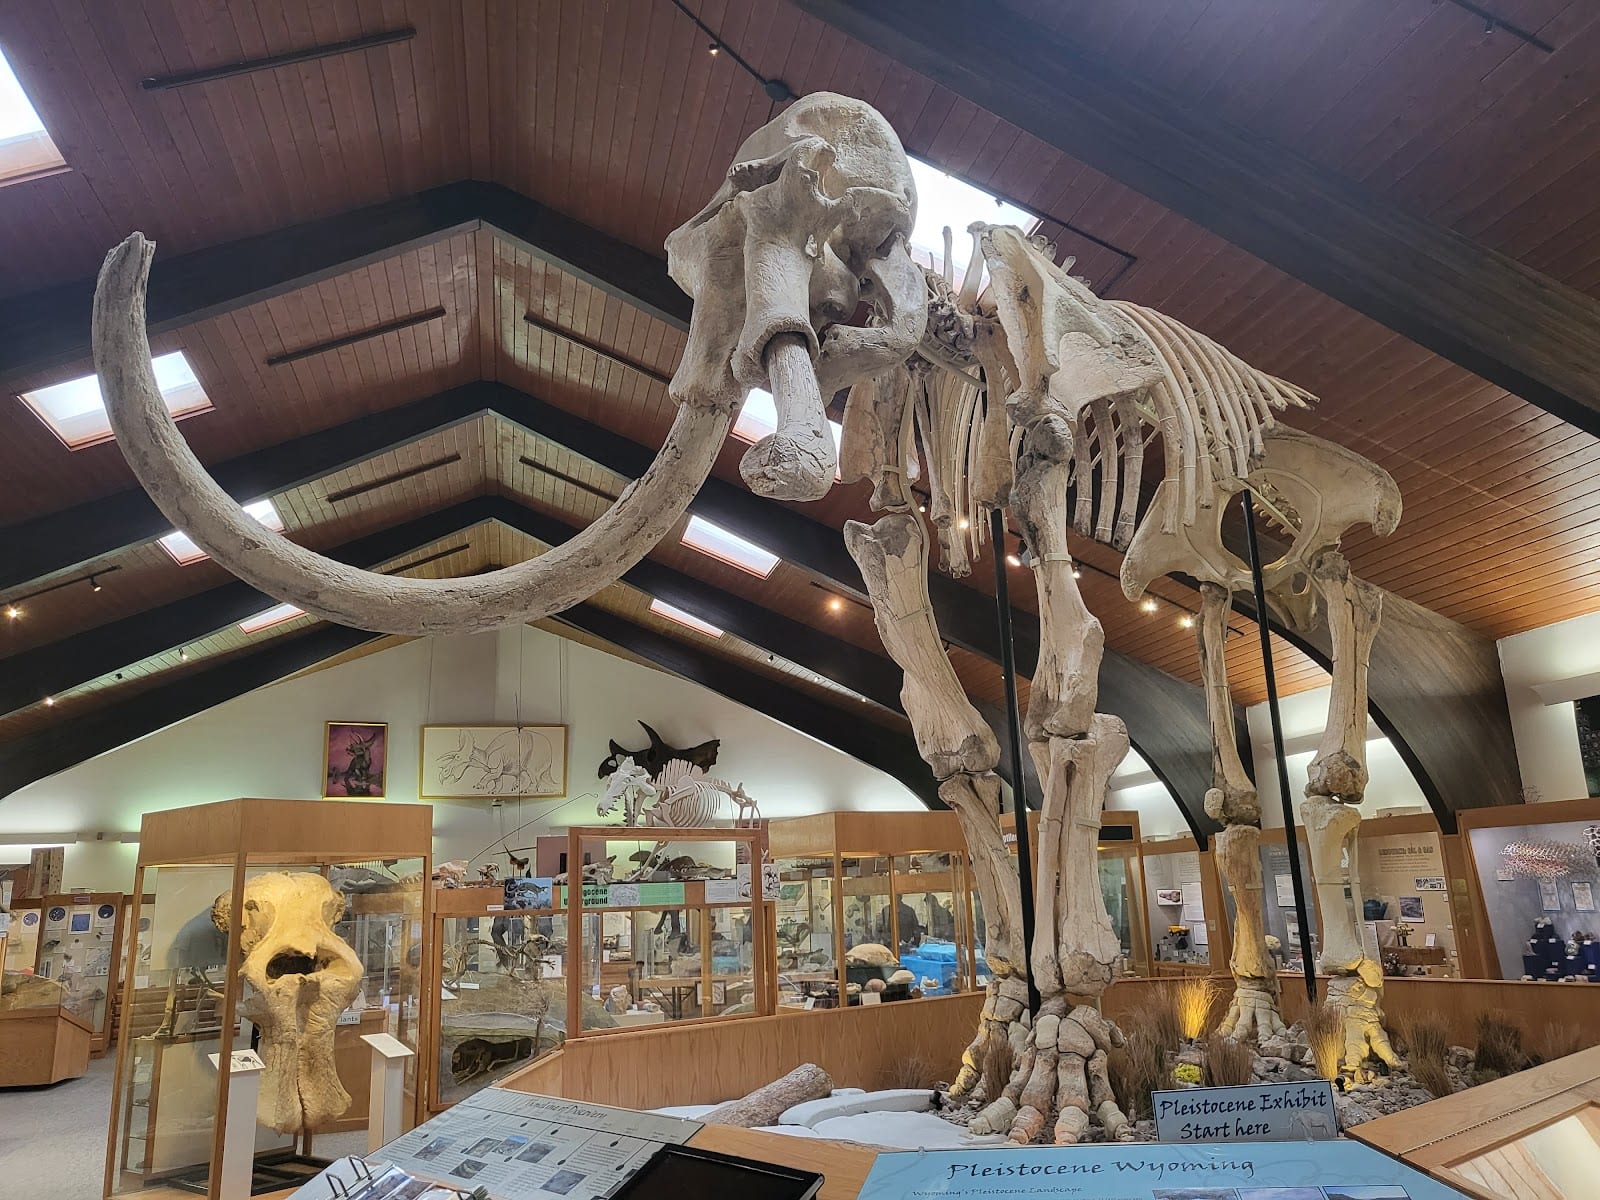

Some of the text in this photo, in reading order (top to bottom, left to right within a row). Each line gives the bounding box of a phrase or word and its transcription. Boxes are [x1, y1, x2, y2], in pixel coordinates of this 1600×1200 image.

[583, 888, 608, 897] gocene
[1160, 1088, 1328, 1119] Pleistocene Exhibit
[1180, 1118, 1271, 1140] Start here
[946, 1157, 1255, 1180] Pleistocene Wyoming
[912, 1188, 969, 1198] Wyoming's
[970, 1187, 1027, 1196] Pleistocene
[1029, 1186, 1083, 1196] Landscape
